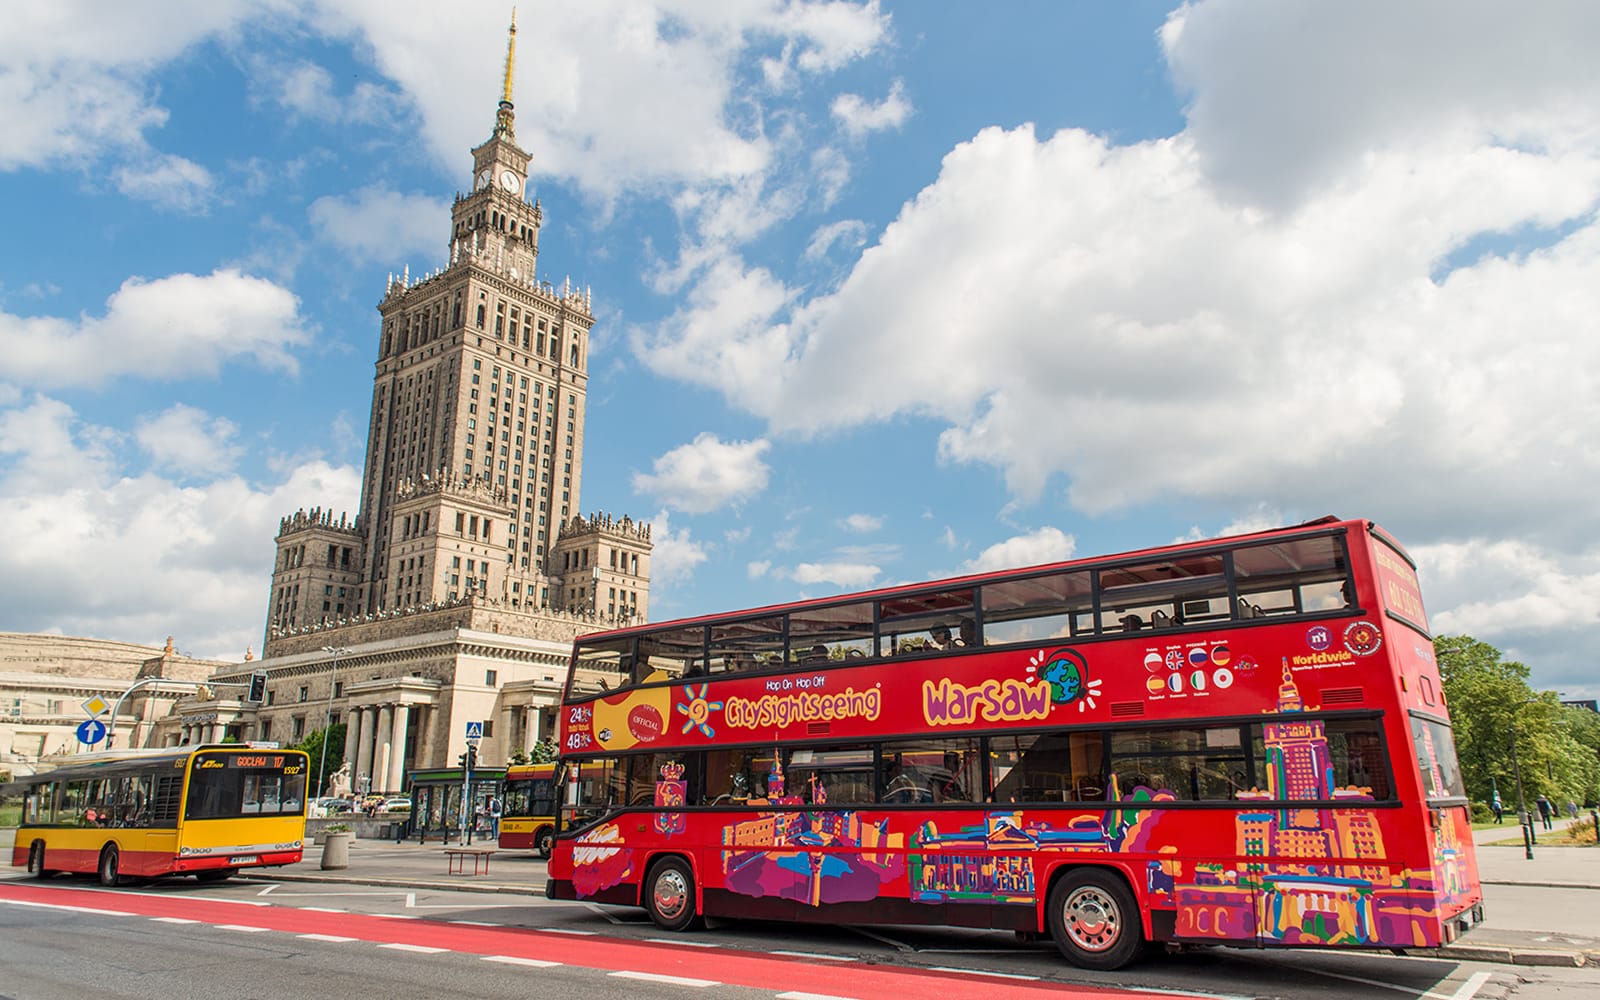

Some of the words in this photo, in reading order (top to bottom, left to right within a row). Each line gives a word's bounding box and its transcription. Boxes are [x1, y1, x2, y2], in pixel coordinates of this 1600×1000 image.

[1292, 650, 1352, 665] Worldwide
[766, 681, 780, 691] Hop
[782, 679, 793, 690] On
[796, 678, 811, 689] Hop
[812, 676, 826, 687] Off
[726, 687, 881, 729] CitySightseeing
[923, 678, 1050, 726] Warsaw
[570, 707, 582, 724] 24
[633, 715, 659, 731] OFFICIAL
[567, 733, 580, 750] 48
